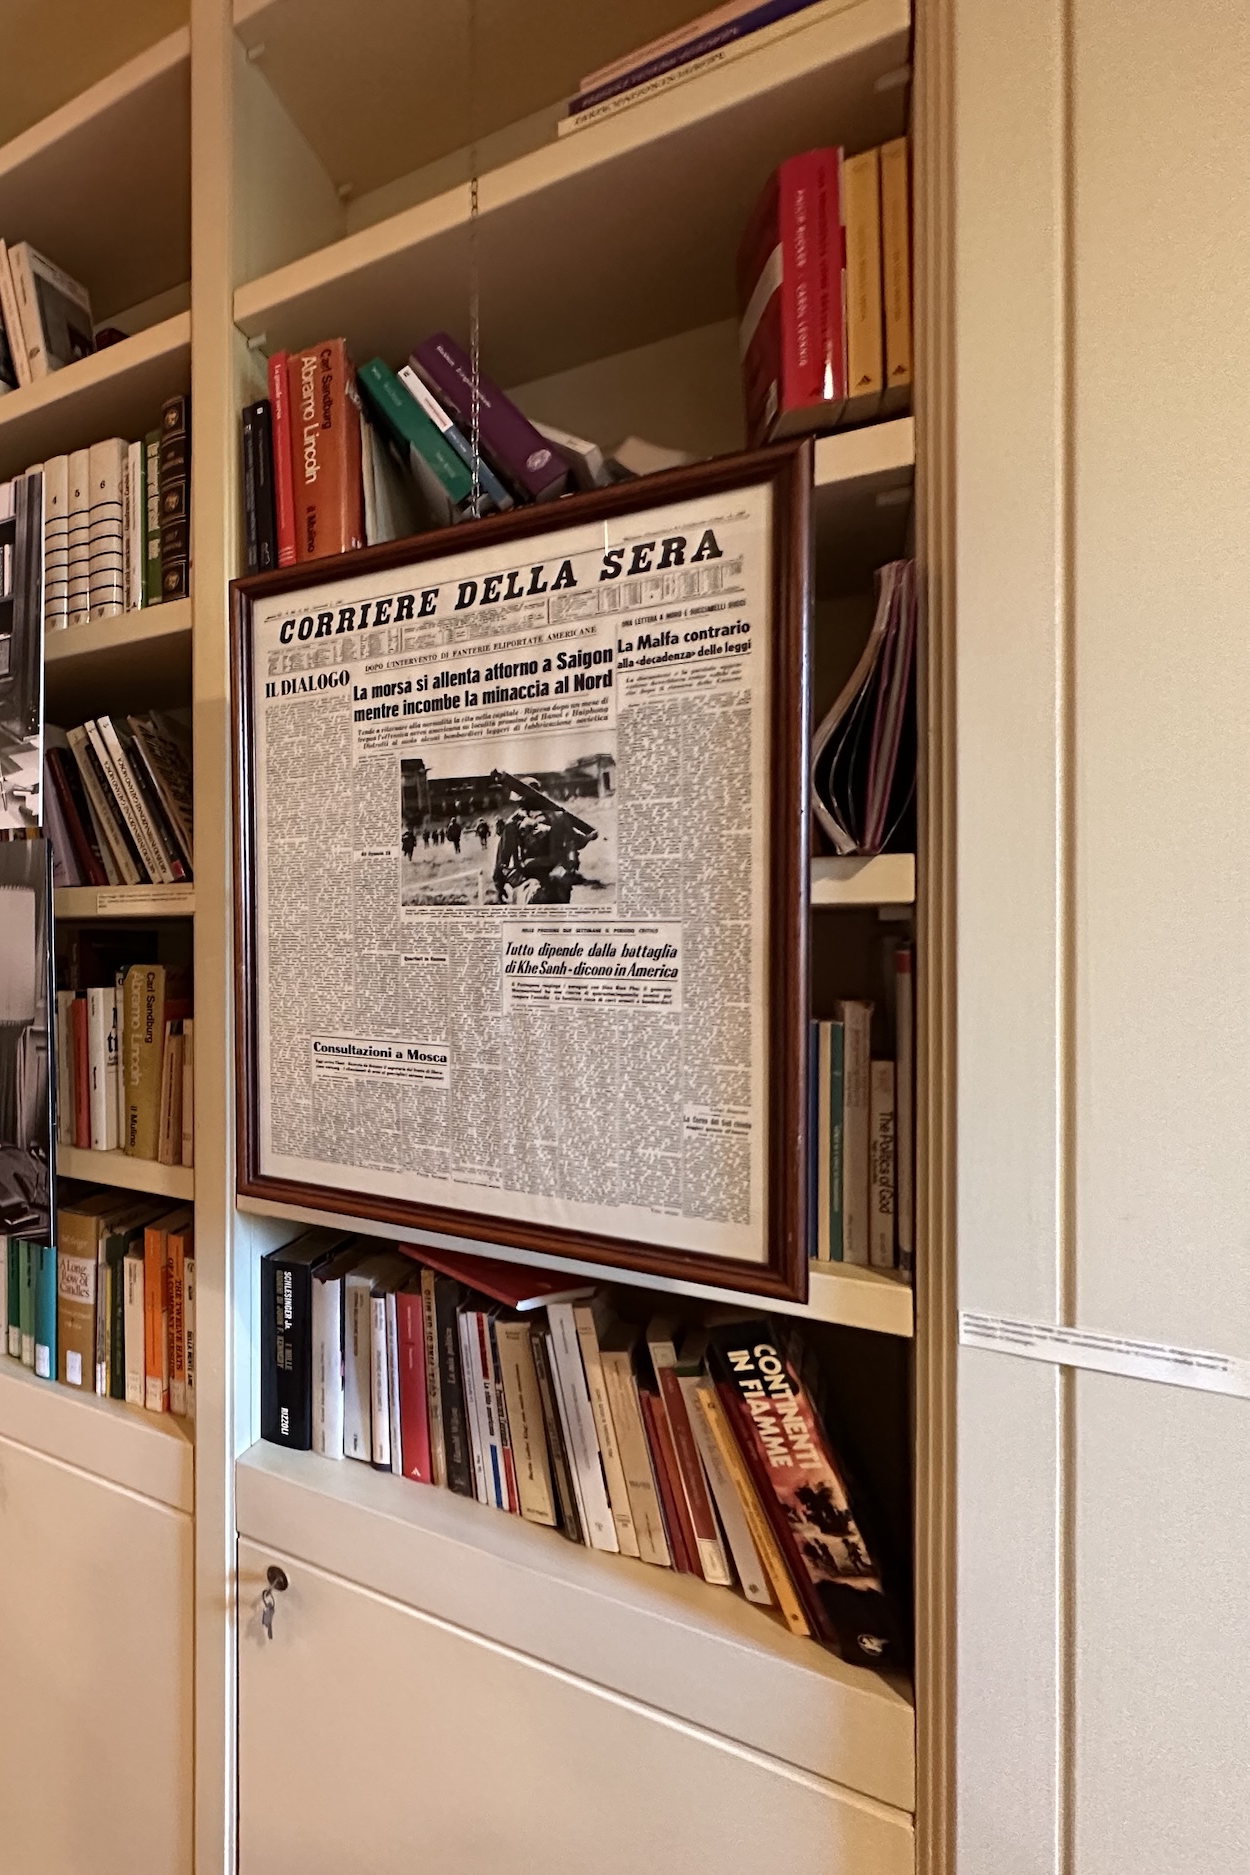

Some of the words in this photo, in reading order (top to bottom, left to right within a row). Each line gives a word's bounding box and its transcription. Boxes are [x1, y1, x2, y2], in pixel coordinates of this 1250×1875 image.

[320, 348, 332, 372] Carl
[302, 356, 318, 421] Abramo
[321, 375, 332, 430] Sandburg
[303, 422, 319, 485] Lincoln
[100, 480, 106, 489] 6
[306, 514, 316, 553] Mulino
[279, 588, 439, 644] CORRIERE
[456, 559, 578, 611] DELLA
[599, 528, 723, 581] SERA
[365, 662, 384, 672] DOPO
[441, 651, 449, 661] DI
[452, 644, 491, 657] FANTERIE
[493, 635, 543, 652] ELIPORTATE
[547, 625, 598, 641] AMERICANE
[617, 638, 633, 654] La
[638, 631, 680, 650] Malfa
[683, 619, 750, 643] contrario
[617, 658, 634, 669] alla
[697, 642, 723, 657] delle
[724, 638, 752, 653] leggi
[266, 682, 279, 698] IL
[281, 670, 350, 696] DIALOGO
[354, 685, 368, 701] La
[371, 680, 412, 698] morsa
[416, 674, 428, 692] si
[433, 667, 480, 688] allenta
[485, 656, 538, 682] attorno
[542, 659, 552, 673] a
[557, 648, 613, 670] Saigon
[354, 702, 399, 722] mentre
[403, 694, 461, 716] incombe
[465, 690, 478, 707] la
[482, 682, 549, 705] minaccia
[555, 676, 569, 694] al
[574, 669, 613, 691] Nord
[601, 697, 609, 705] di
[541, 710, 563, 722] Hanoi
[572, 705, 609, 719] Haiphong
[505, 942, 534, 957] Tutto
[537, 943, 584, 960] dipende
[587, 943, 617, 958] dalla
[620, 943, 678, 962] battaglia
[146, 972, 155, 993] Carl
[505, 961, 516, 973] di
[517, 962, 539, 975] Khe
[539, 962, 567, 976] Sanh
[614, 964, 627, 977] in
[627, 963, 678, 979] America
[131, 971, 142, 1029] Abramo
[145, 994, 156, 1043] Sandburg
[130, 1033, 143, 1087] Lincoln
[313, 1041, 392, 1059] Consultazioni
[395, 1051, 403, 1059] a
[406, 1049, 447, 1063] Mosca
[879, 1111, 893, 1132] The
[879, 1135, 893, 1174] Politics
[880, 1176, 893, 1187] of
[879, 1189, 893, 1215] God
[284, 1271, 292, 1319] SCHLESINGER
[426, 1316, 432, 1327] UN
[427, 1332, 432, 1341] DI
[727, 1349, 754, 1372] IN
[281, 1407, 289, 1435] RIZZOLI
[754, 1343, 822, 1469] CONTINENTI
[739, 1379, 793, 1468] FIAMME
